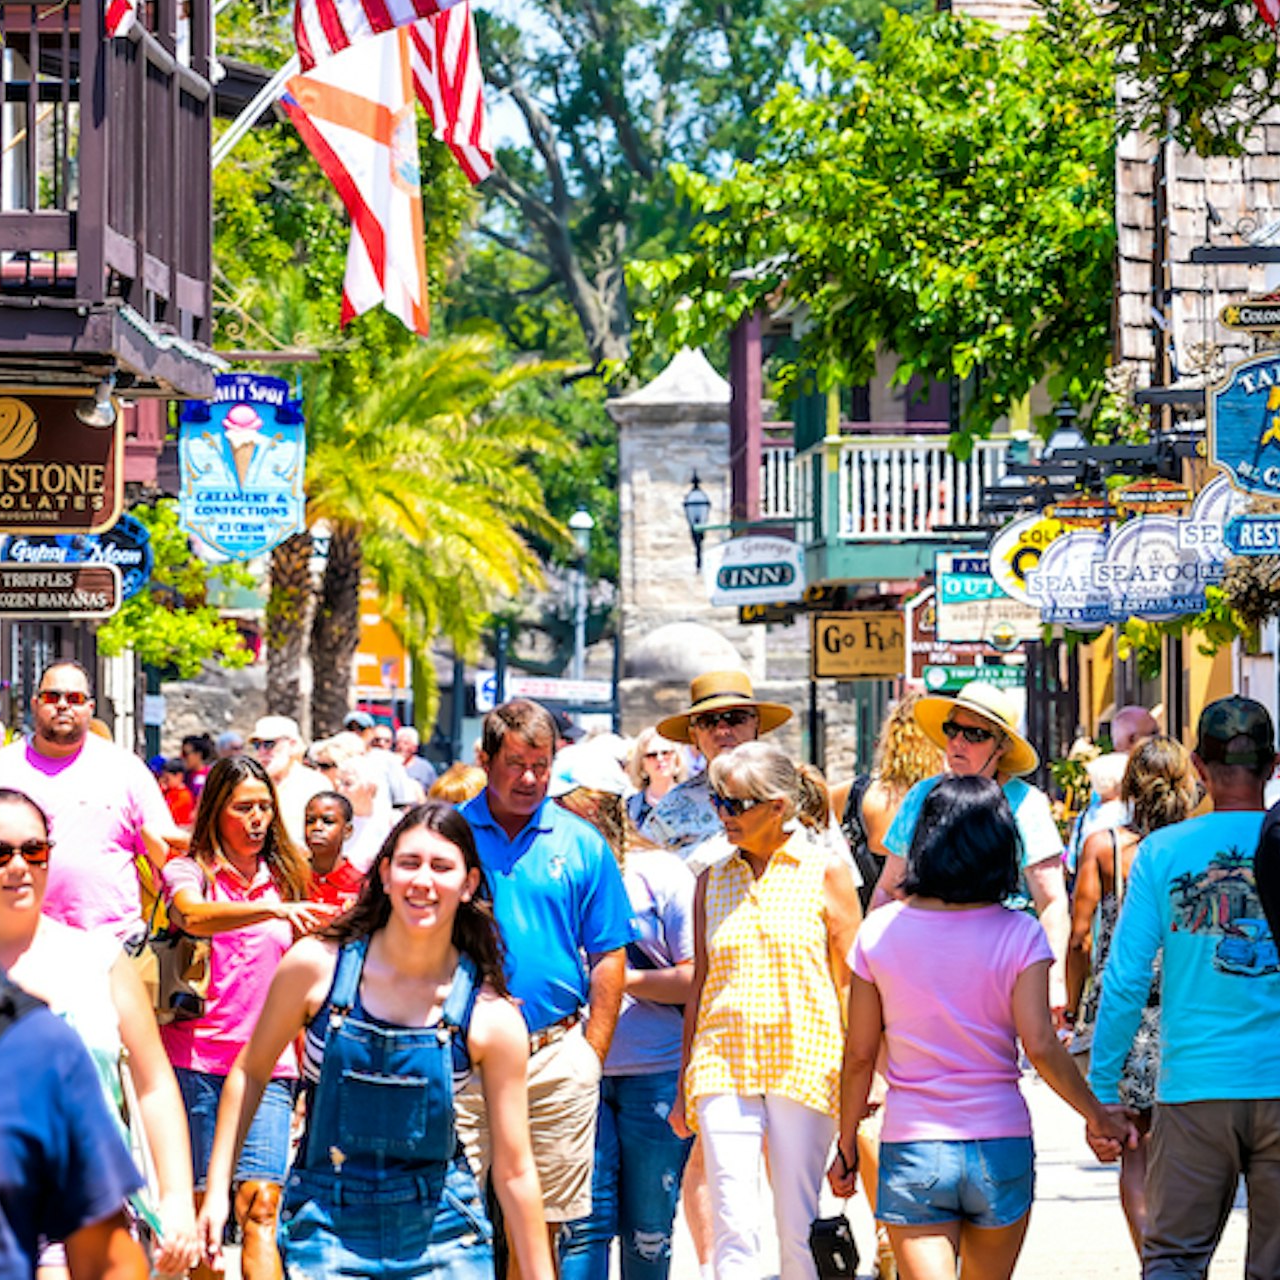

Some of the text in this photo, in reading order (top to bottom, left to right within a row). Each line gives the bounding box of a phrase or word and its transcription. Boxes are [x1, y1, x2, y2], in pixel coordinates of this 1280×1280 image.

[194, 505, 289, 517] CONFECTIONS
[87, 541, 143, 565] Moon
[2, 573, 73, 588] TRUFFLES
[730, 565, 782, 587] INN
[1098, 563, 1197, 582] SEAFOO
[37, 592, 107, 609] BANANAS
[823, 624, 856, 653] Go
